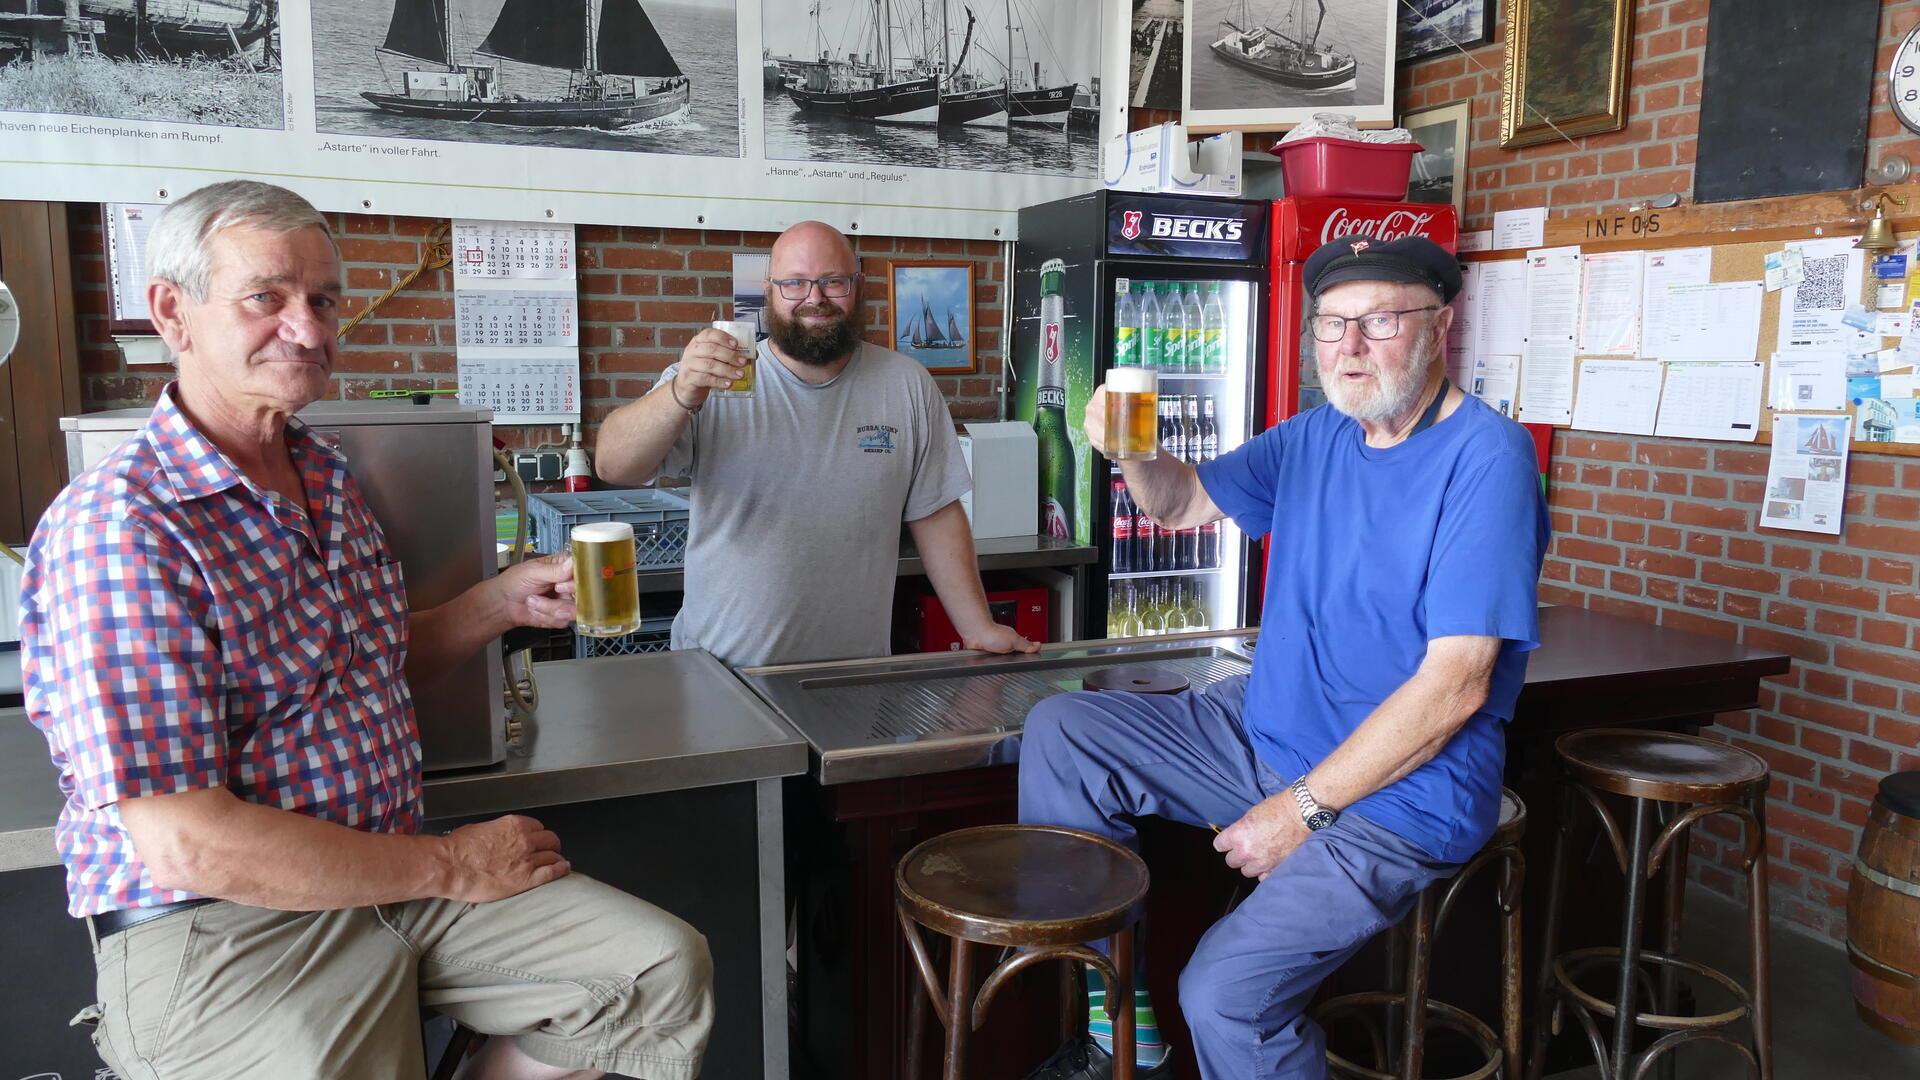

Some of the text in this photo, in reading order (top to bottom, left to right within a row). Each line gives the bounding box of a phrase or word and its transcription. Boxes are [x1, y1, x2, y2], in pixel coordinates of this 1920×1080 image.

[1902, 66, 1914, 78] 9
[1904, 90, 1918, 101] 8
[0, 121, 36, 132] haven
[38, 124, 68, 133] neue
[71, 124, 158, 140] Eichenplanken
[182, 132, 224, 144] Rumpf.
[370, 145, 380, 154] in
[381, 146, 409, 156] voller
[412, 148, 440, 158] Fahrt.
[849, 171, 865, 180] und
[1152, 217, 1243, 240] BECK'S
[1586, 214, 1660, 238] INFOS
